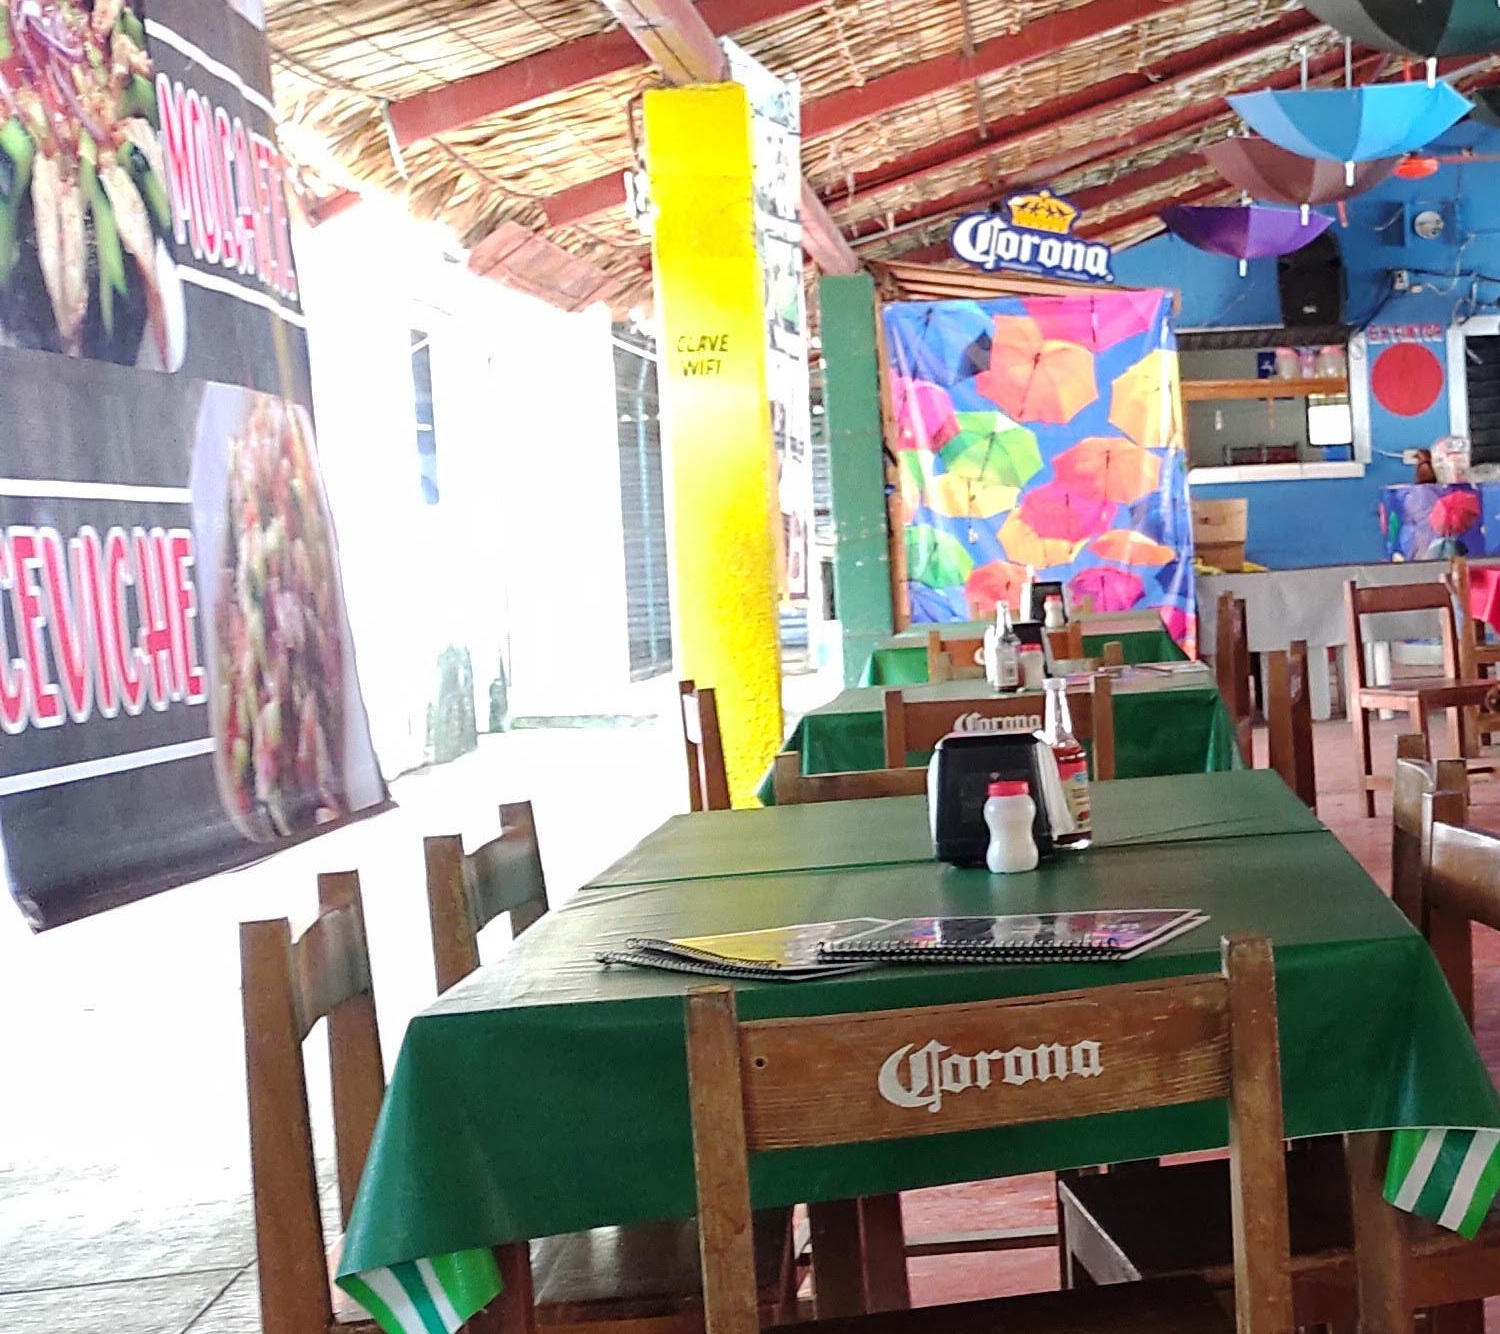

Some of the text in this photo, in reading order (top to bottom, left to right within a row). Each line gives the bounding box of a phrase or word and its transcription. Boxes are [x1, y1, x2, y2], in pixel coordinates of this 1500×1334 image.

[952, 214, 1109, 277] Corona
[677, 333, 729, 353] CLAVE
[877, 1038, 1105, 1114] Corona
